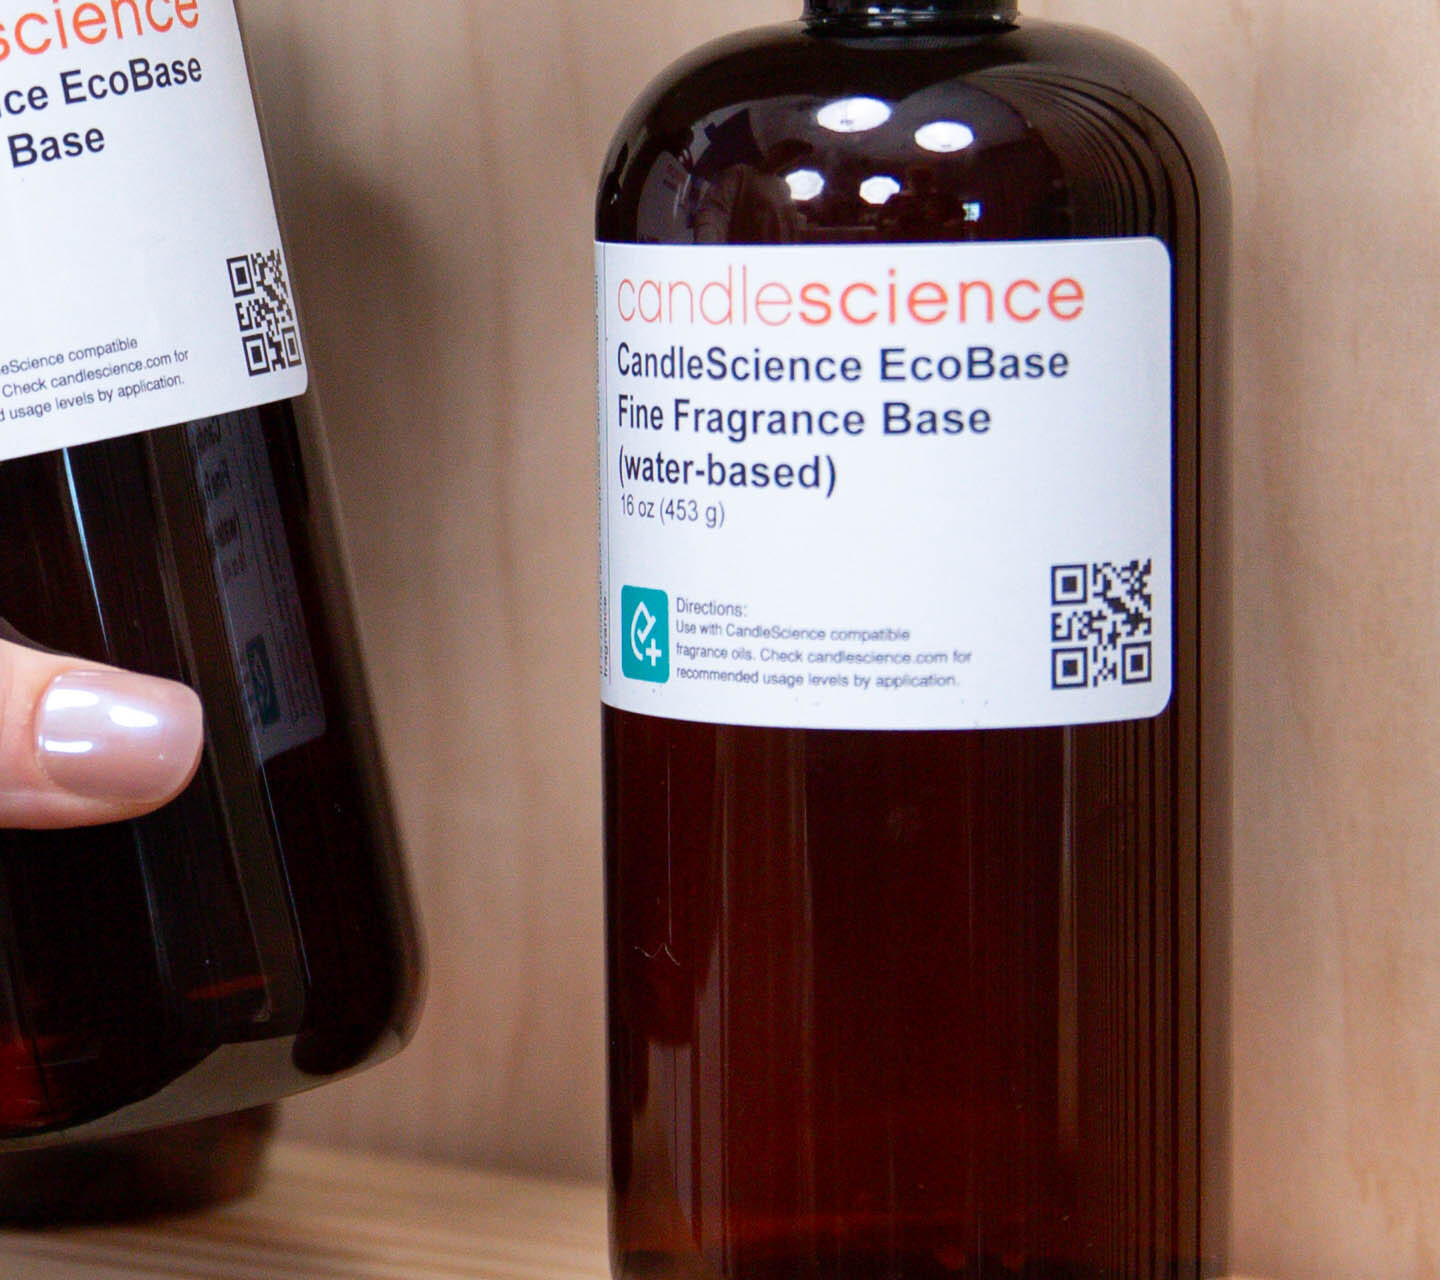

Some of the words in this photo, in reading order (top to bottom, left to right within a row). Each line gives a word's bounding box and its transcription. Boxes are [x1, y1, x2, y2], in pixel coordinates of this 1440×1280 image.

[60, 56, 203, 105] EcoBase
[8, 127, 105, 168] Base
[617, 264, 1085, 326] candlescience
[68, 337, 138, 363] compatible
[617, 341, 862, 381] CandleScience
[880, 345, 1070, 382] EcoBase
[2, 378, 47, 398] Check
[51, 354, 171, 388] candlescience.com
[174, 349, 189, 363] for
[9, 401, 52, 419] usage
[55, 392, 95, 410] levels
[97, 388, 113, 403] by
[118, 375, 184, 398] application.
[618, 393, 664, 431] Fine
[674, 397, 865, 443] Fragrance
[883, 401, 992, 436] Base
[619, 445, 837, 499] (water-based)
[621, 493, 634, 516] 16
[638, 500, 655, 519] oz
[659, 497, 699, 526] (453
[705, 501, 725, 529] g)
[676, 597, 748, 617] Directions:
[676, 619, 697, 634] Use
[700, 622, 722, 636] with
[726, 623, 826, 640] CandleScience
[830, 627, 911, 644] compatible
[676, 642, 728, 660] fragrance
[731, 647, 756, 661] oils.
[760, 648, 803, 663] Check
[807, 650, 948, 664] candlescience.com
[953, 650, 972, 664] for
[676, 667, 759, 684] recommended
[763, 672, 804, 688] usage
[808, 673, 849, 687] levels
[854, 673, 871, 690] by
[875, 673, 960, 691] application.
